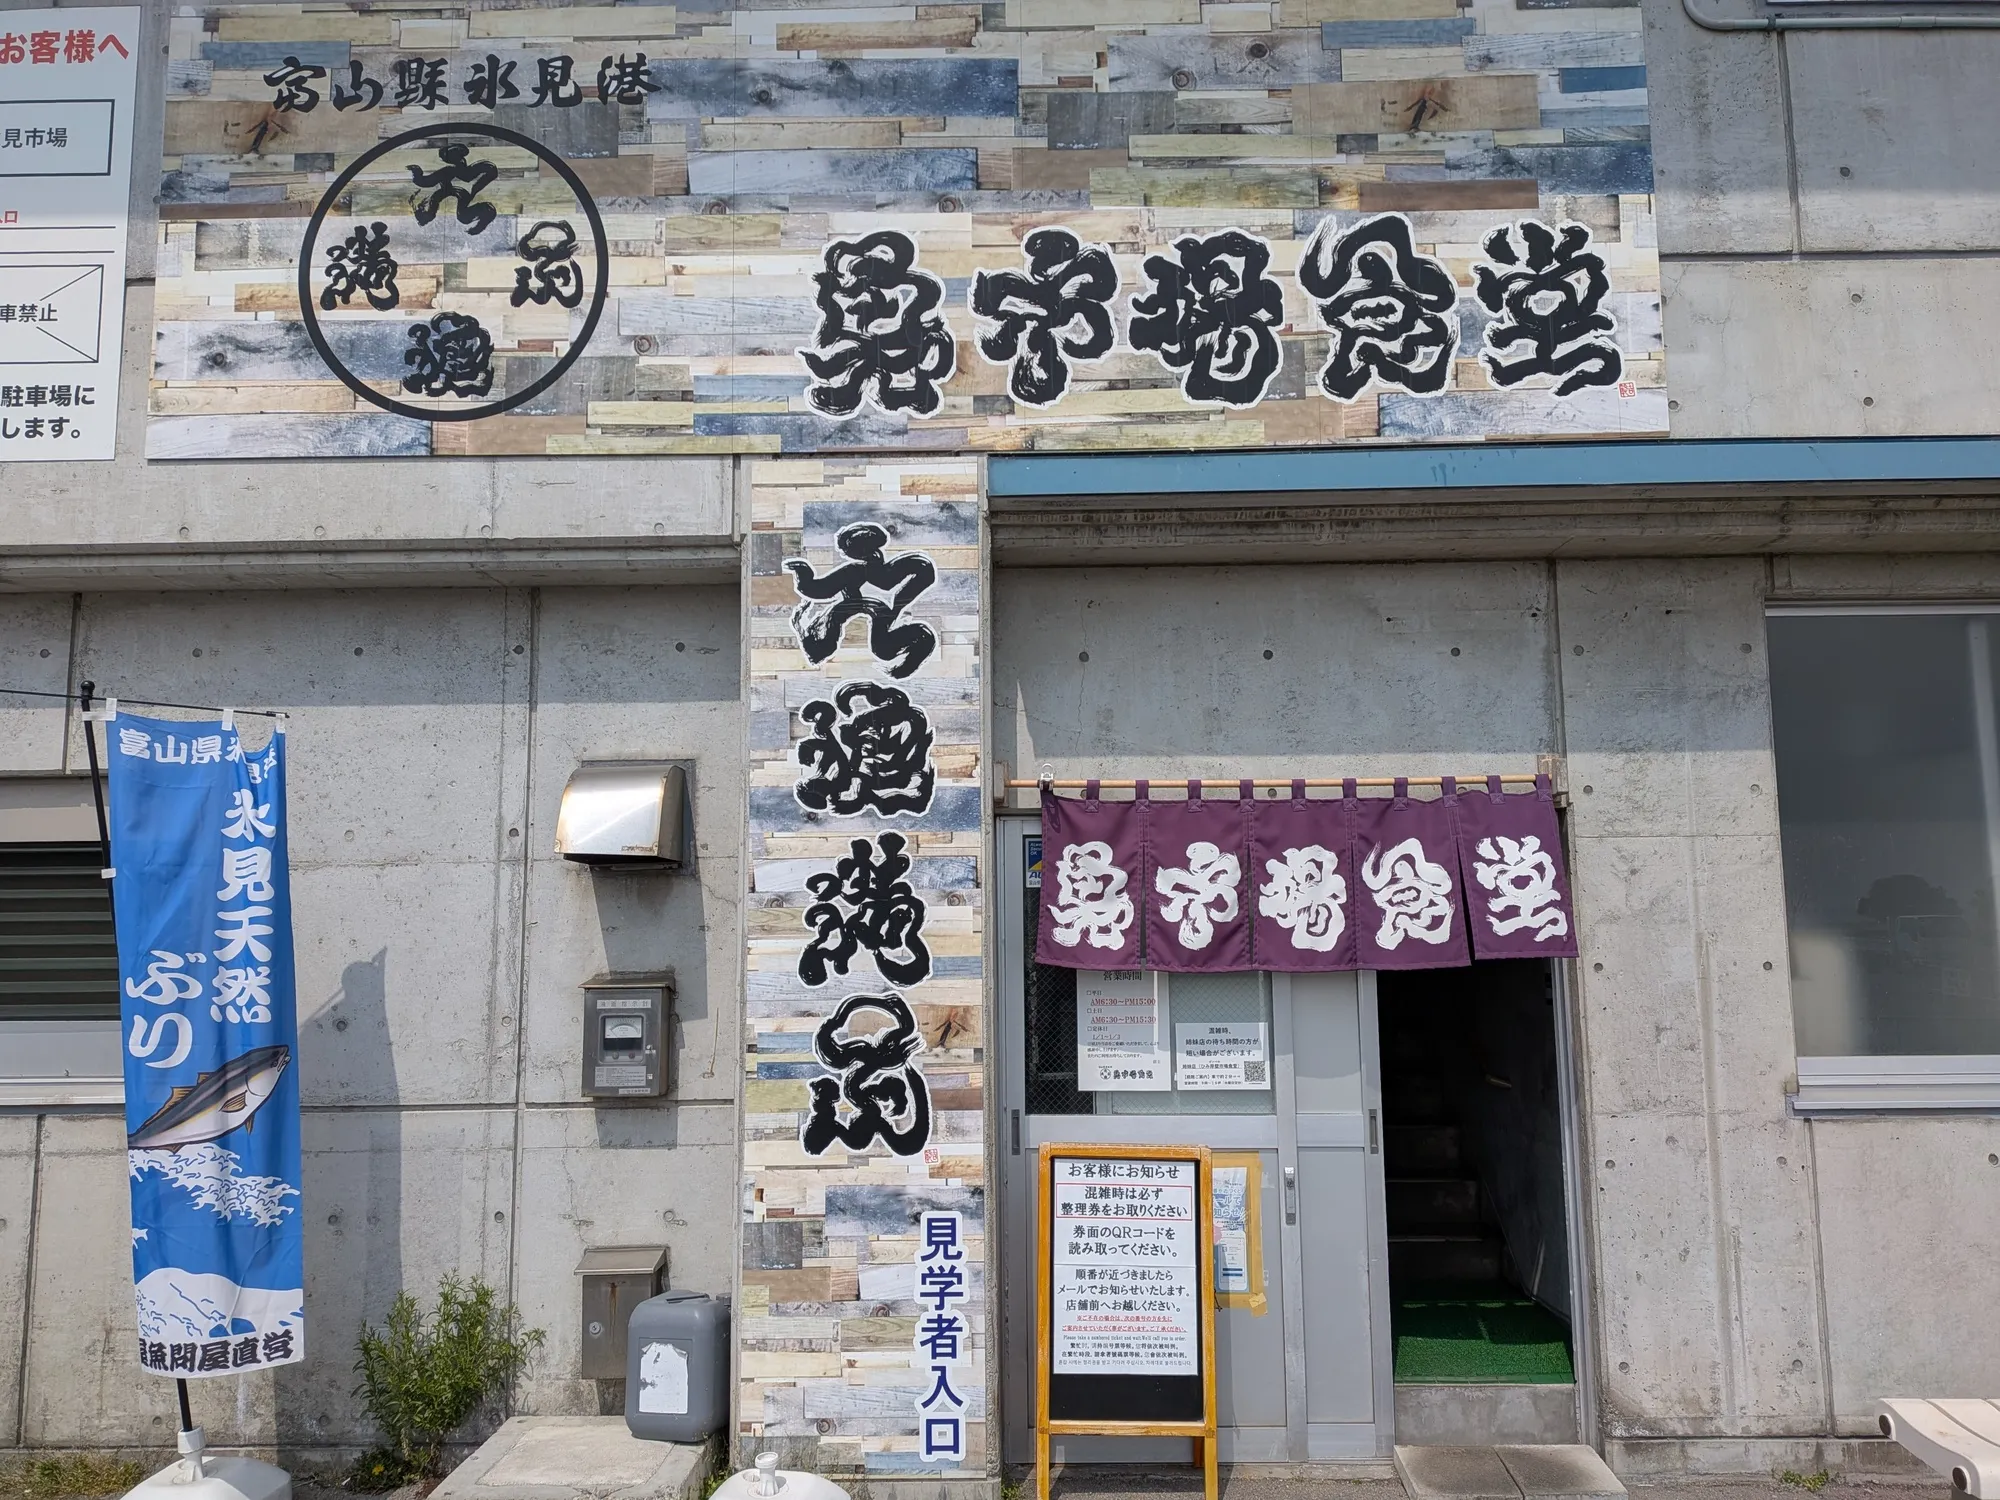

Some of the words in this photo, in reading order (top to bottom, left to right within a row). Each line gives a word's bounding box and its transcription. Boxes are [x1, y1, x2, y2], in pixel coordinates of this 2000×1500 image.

[0, 29, 129, 64] お客様へ
[0, 127, 68, 149] 見市場
[2, 416, 81, 439] します。
[210, 788, 277, 1025] 氷見天然
[125, 950, 207, 1069] ぶり
[1068, 1163, 1180, 1179] お客様にお知らせ
[1084, 1185, 1164, 1201] 混雑時は必ず
[1060, 1203, 1188, 1217] 整理券をお取りください
[1072, 1224, 1176, 1240] 券面のQRコードを
[1068, 1242, 1178, 1258] 読み取ってください。
[1075, 1268, 1174, 1281] 順番が近づきましたら
[1057, 1284, 1190, 1297] メールでお知らせいたします。
[1065, 1299, 1181, 1313] 店舗前へお越しください。
[919, 1217, 964, 1455] 見学者入口
